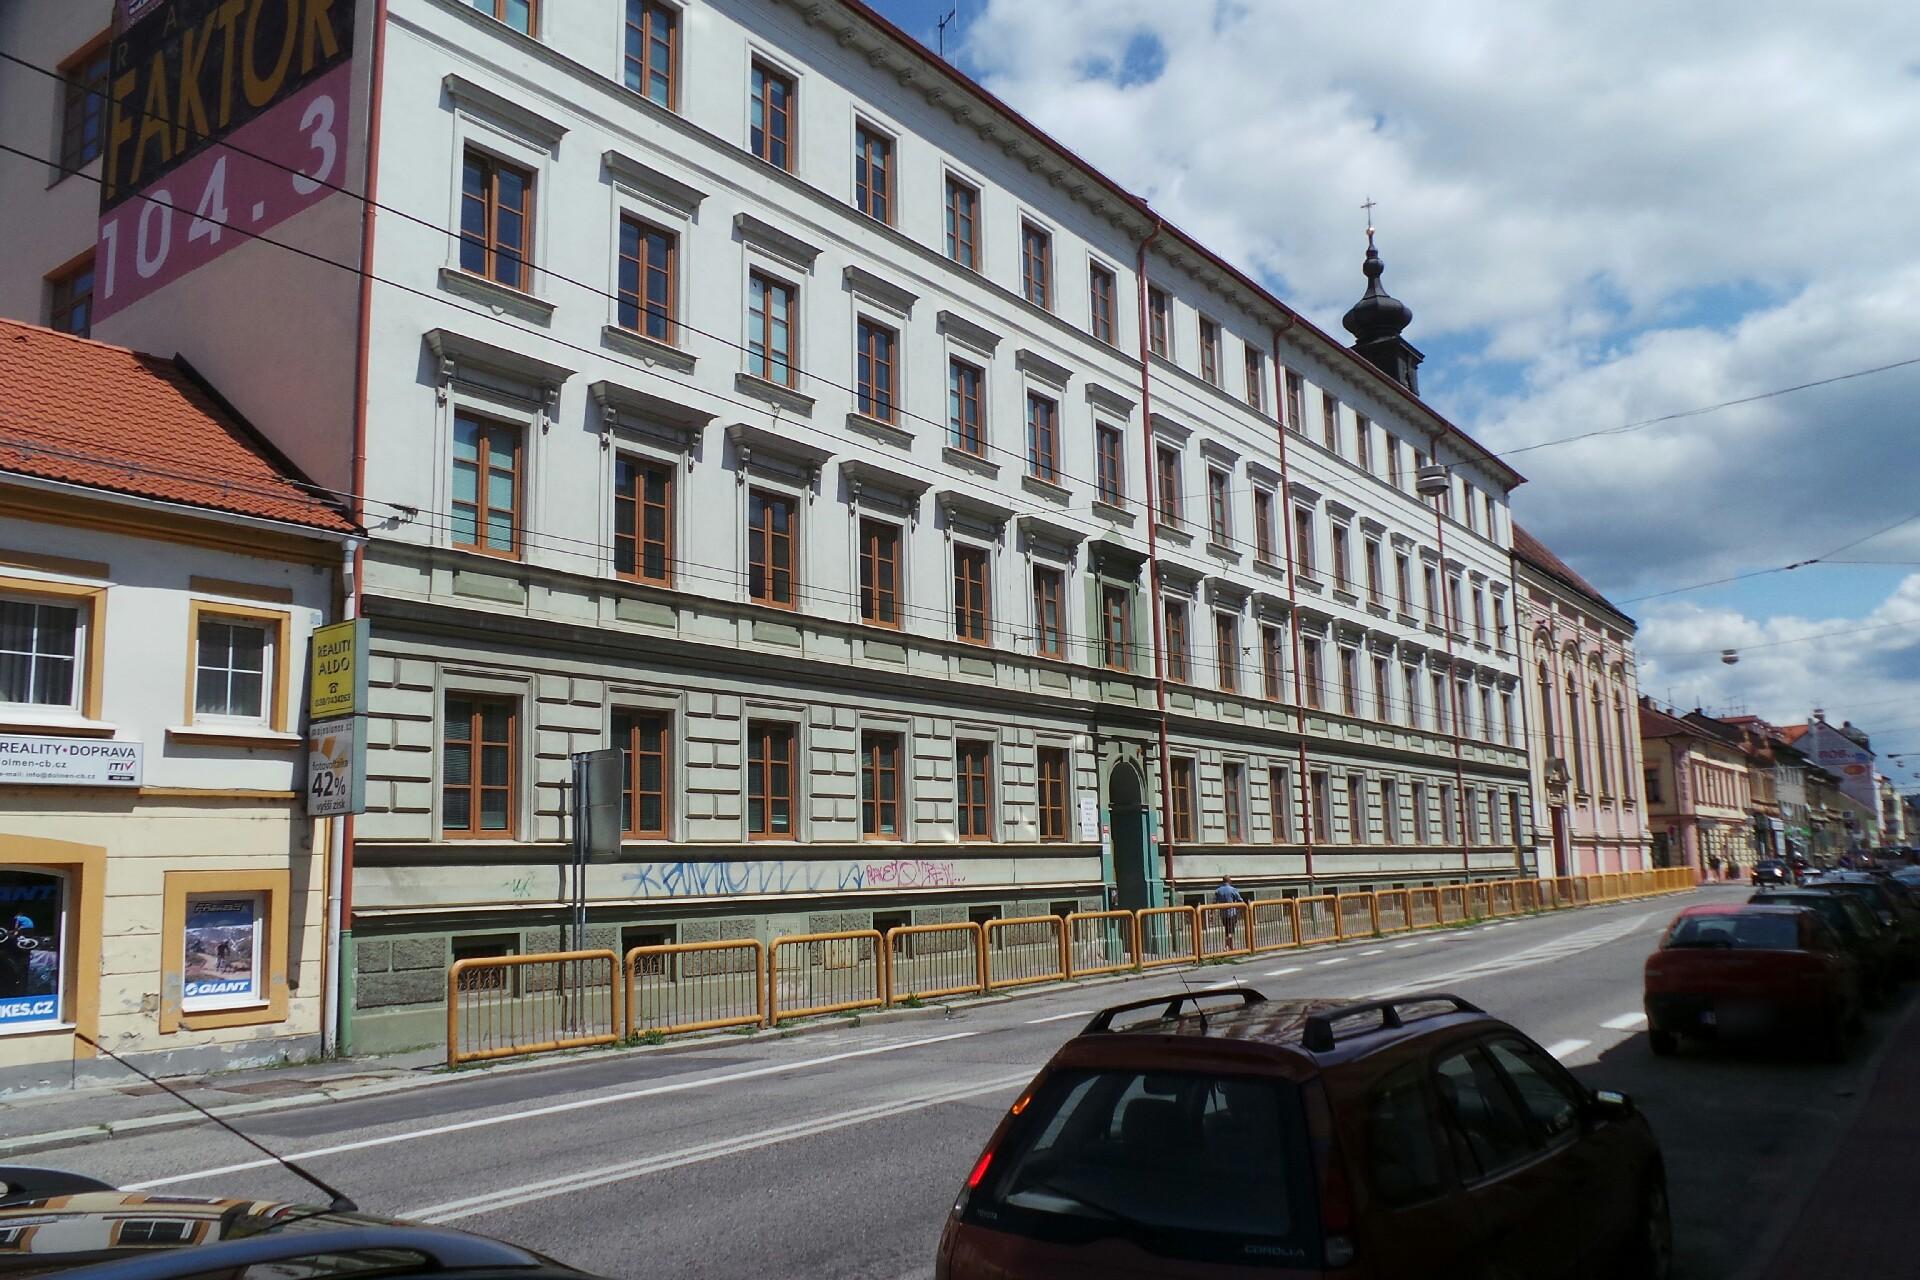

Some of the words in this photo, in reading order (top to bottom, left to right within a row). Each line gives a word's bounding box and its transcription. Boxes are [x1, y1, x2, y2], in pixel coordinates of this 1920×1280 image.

[107, 0, 340, 200] FAKTOR
[102, 94, 337, 300] 104.3
[317, 640, 351, 657] REALITY
[318, 657, 350, 675] ALDO
[311, 771, 346, 798] 42%
[198, 982, 249, 994] GIANT
